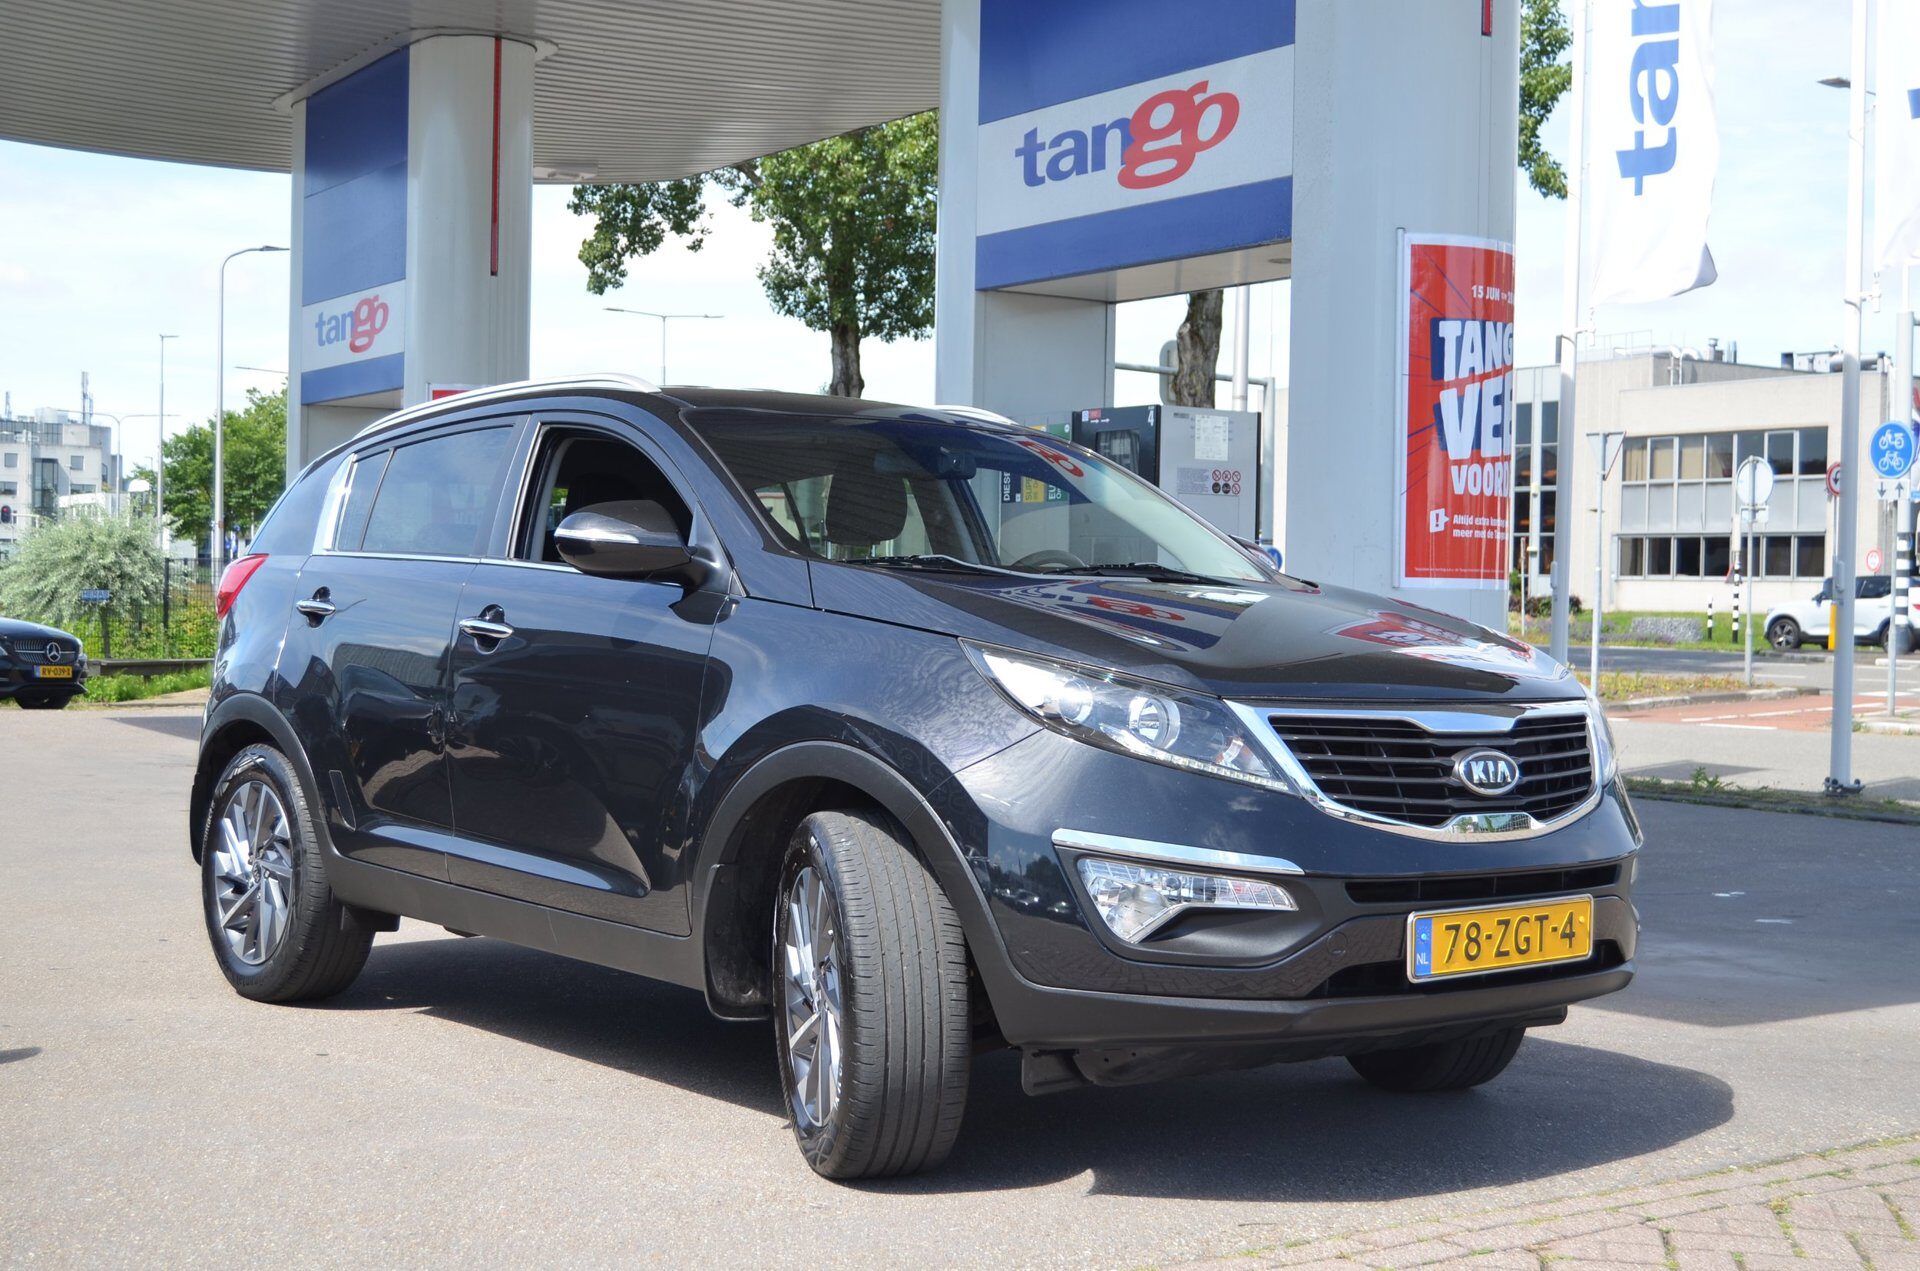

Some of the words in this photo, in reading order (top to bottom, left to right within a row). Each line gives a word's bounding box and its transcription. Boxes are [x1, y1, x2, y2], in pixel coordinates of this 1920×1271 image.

[1014, 80, 1240, 190] tango
[1471, 284, 1484, 299] 15
[1485, 286, 1500, 301] JUN
[315, 295, 389, 353] tango
[1147, 409, 1155, 427] 4
[1453, 514, 1473, 526] Altijd
[1452, 529, 1473, 538] meer
[1469, 760, 1512, 784] KIA
[1443, 911, 1576, 964] 78-ZGT-4
[1416, 952, 1429, 965] NL
